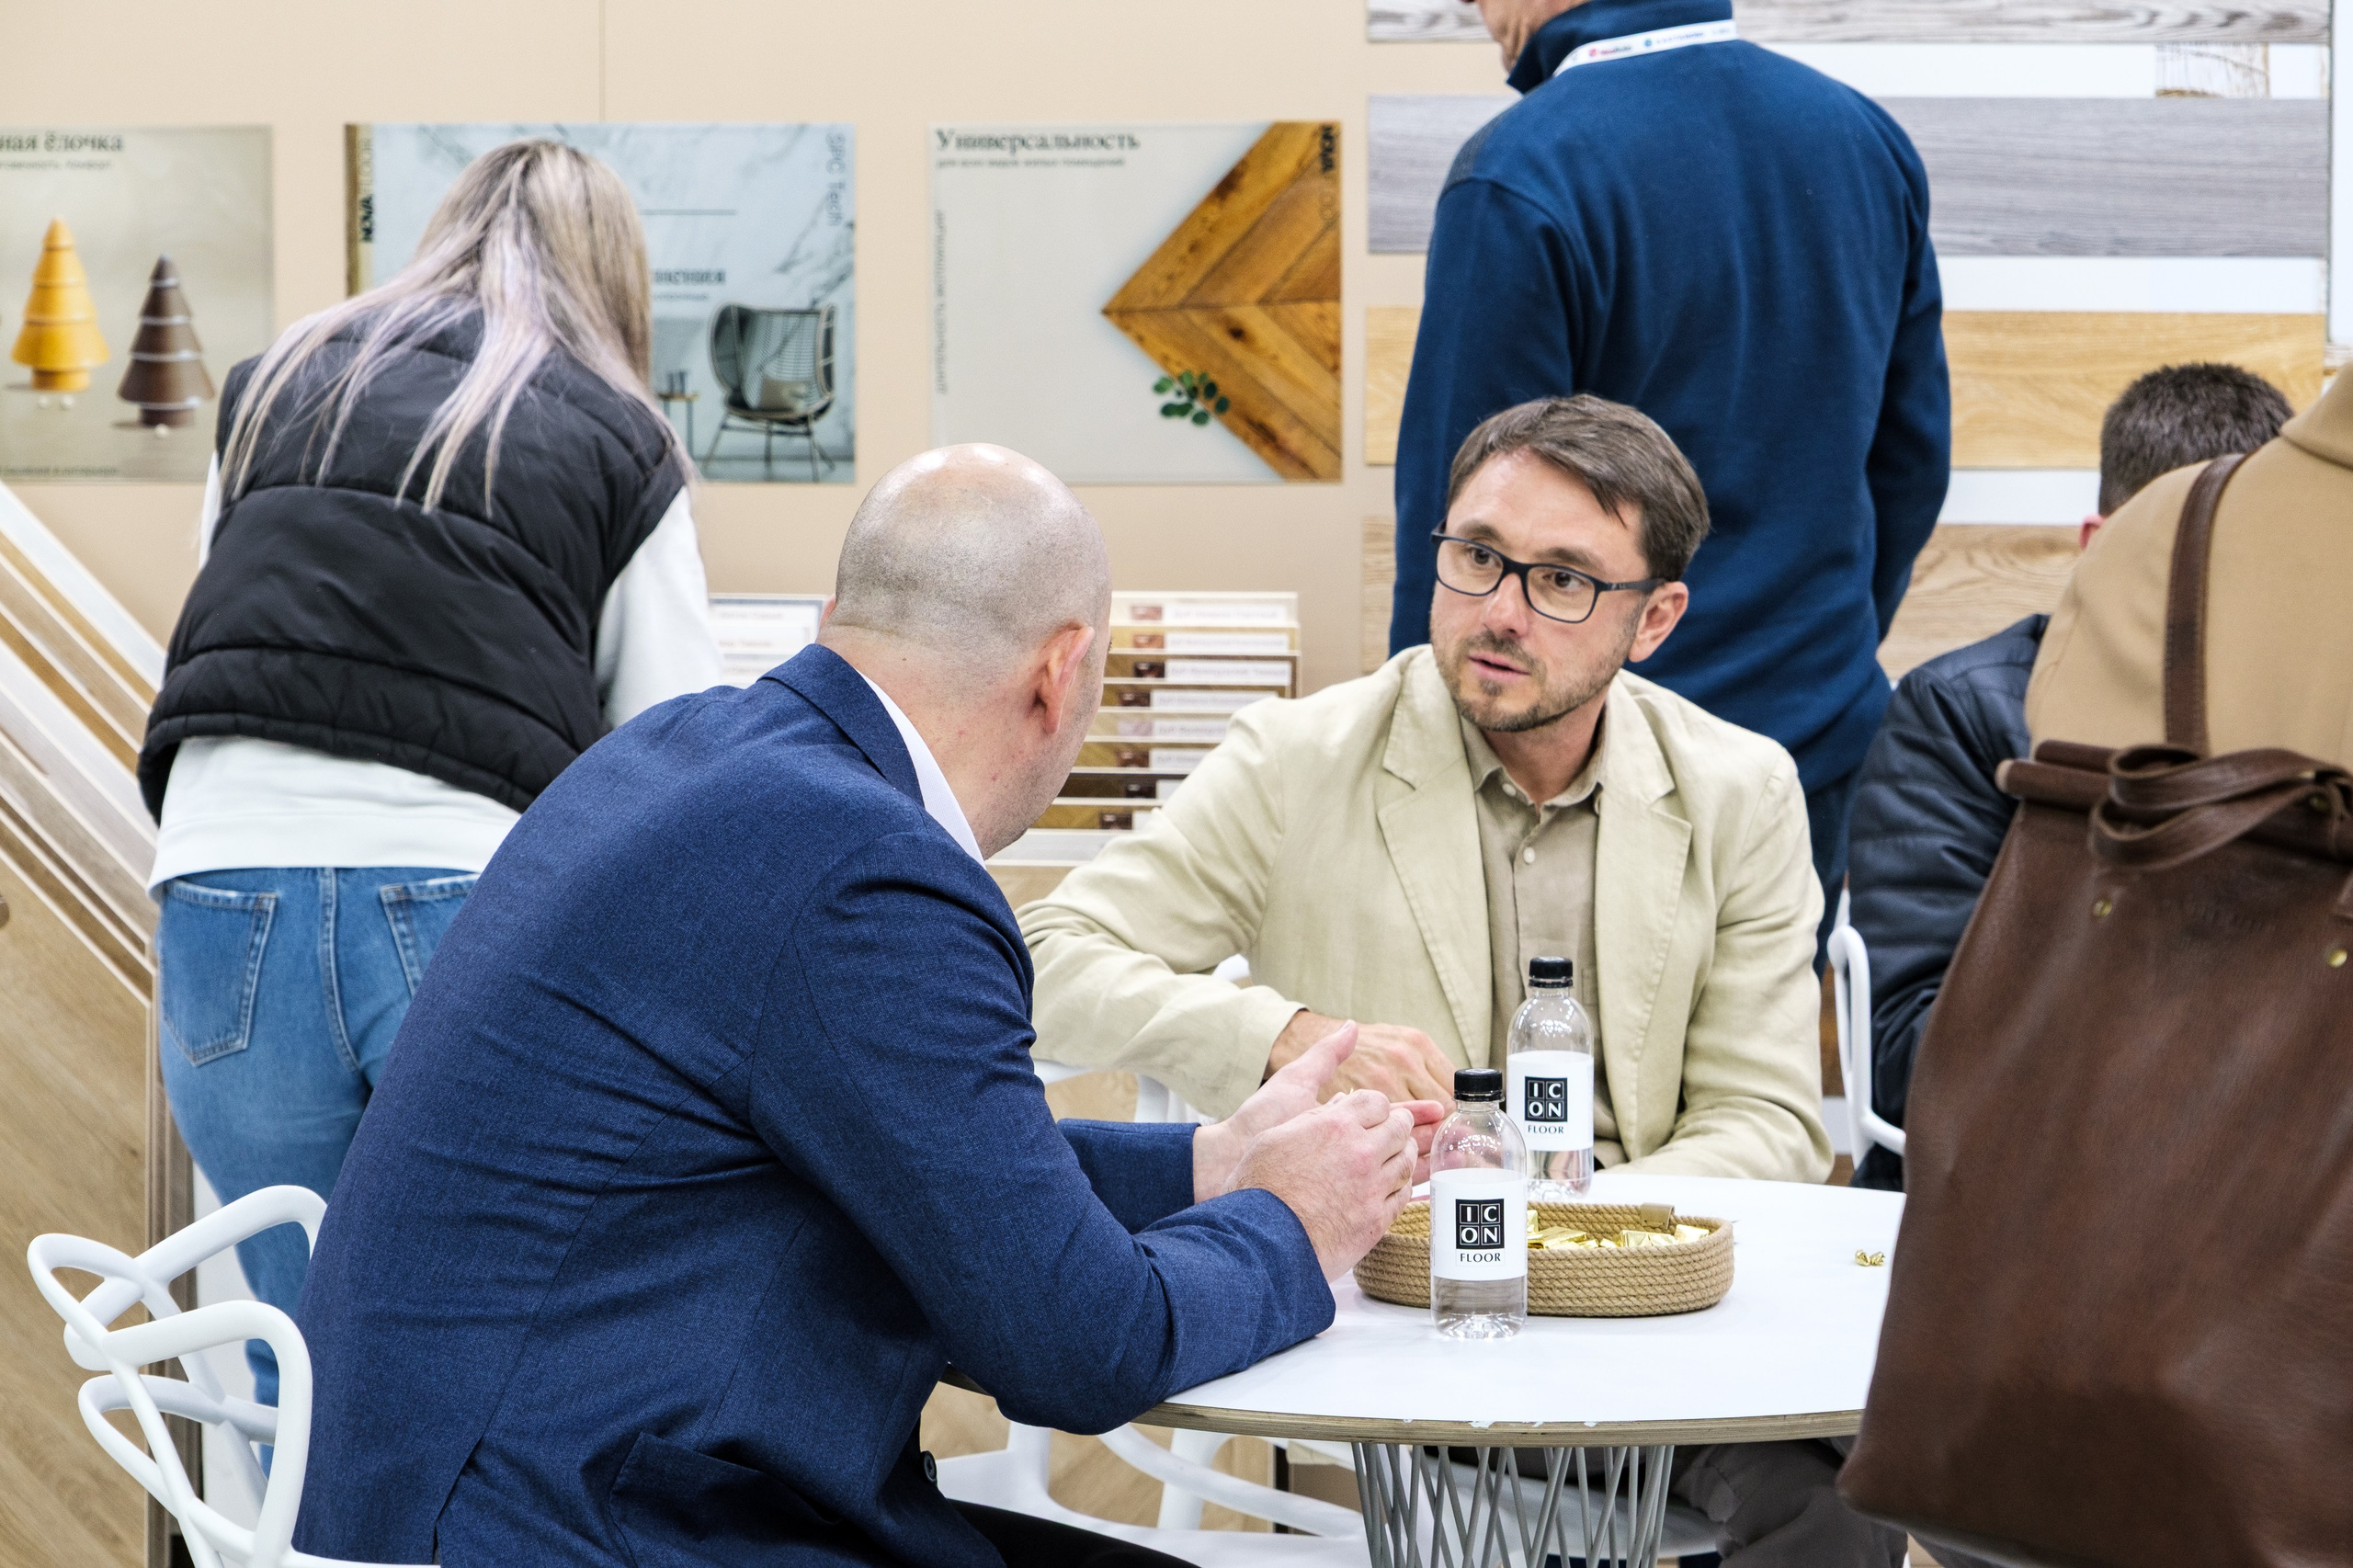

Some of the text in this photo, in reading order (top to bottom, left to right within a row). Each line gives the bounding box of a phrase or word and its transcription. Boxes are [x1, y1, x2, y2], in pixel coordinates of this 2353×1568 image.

[937, 129, 1141, 155] Универсальность
[826, 133, 847, 174] SPC
[1528, 1125, 1564, 1134] FLOOR
[1460, 1253, 1501, 1262] FLOOR
